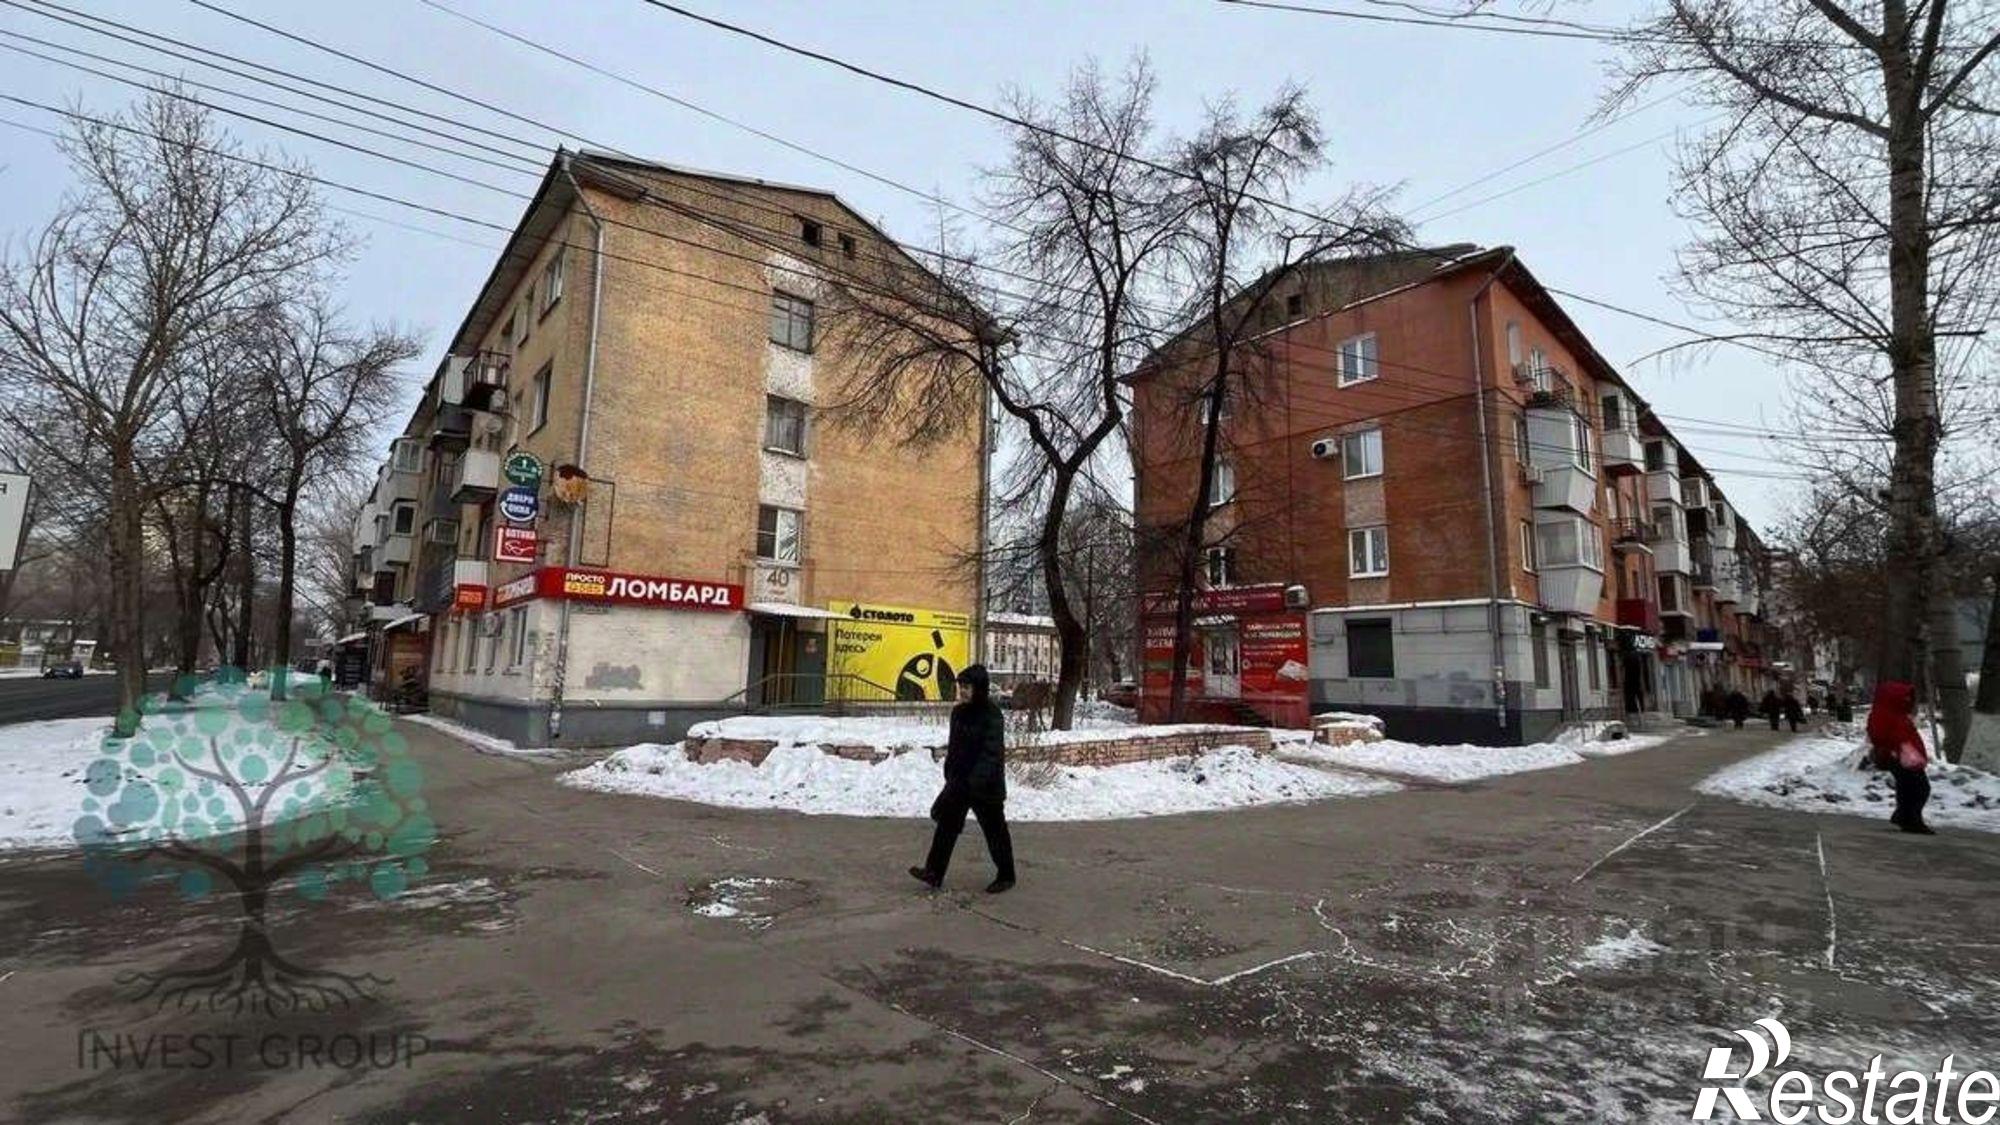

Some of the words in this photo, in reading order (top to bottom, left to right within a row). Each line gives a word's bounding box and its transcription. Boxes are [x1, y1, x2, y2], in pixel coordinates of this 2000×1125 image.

[565, 572, 605, 584] ПРОСТО
[767, 569, 789, 587] 40
[607, 577, 731, 605] ЛОМБАРД
[835, 629, 882, 643] Лотереи
